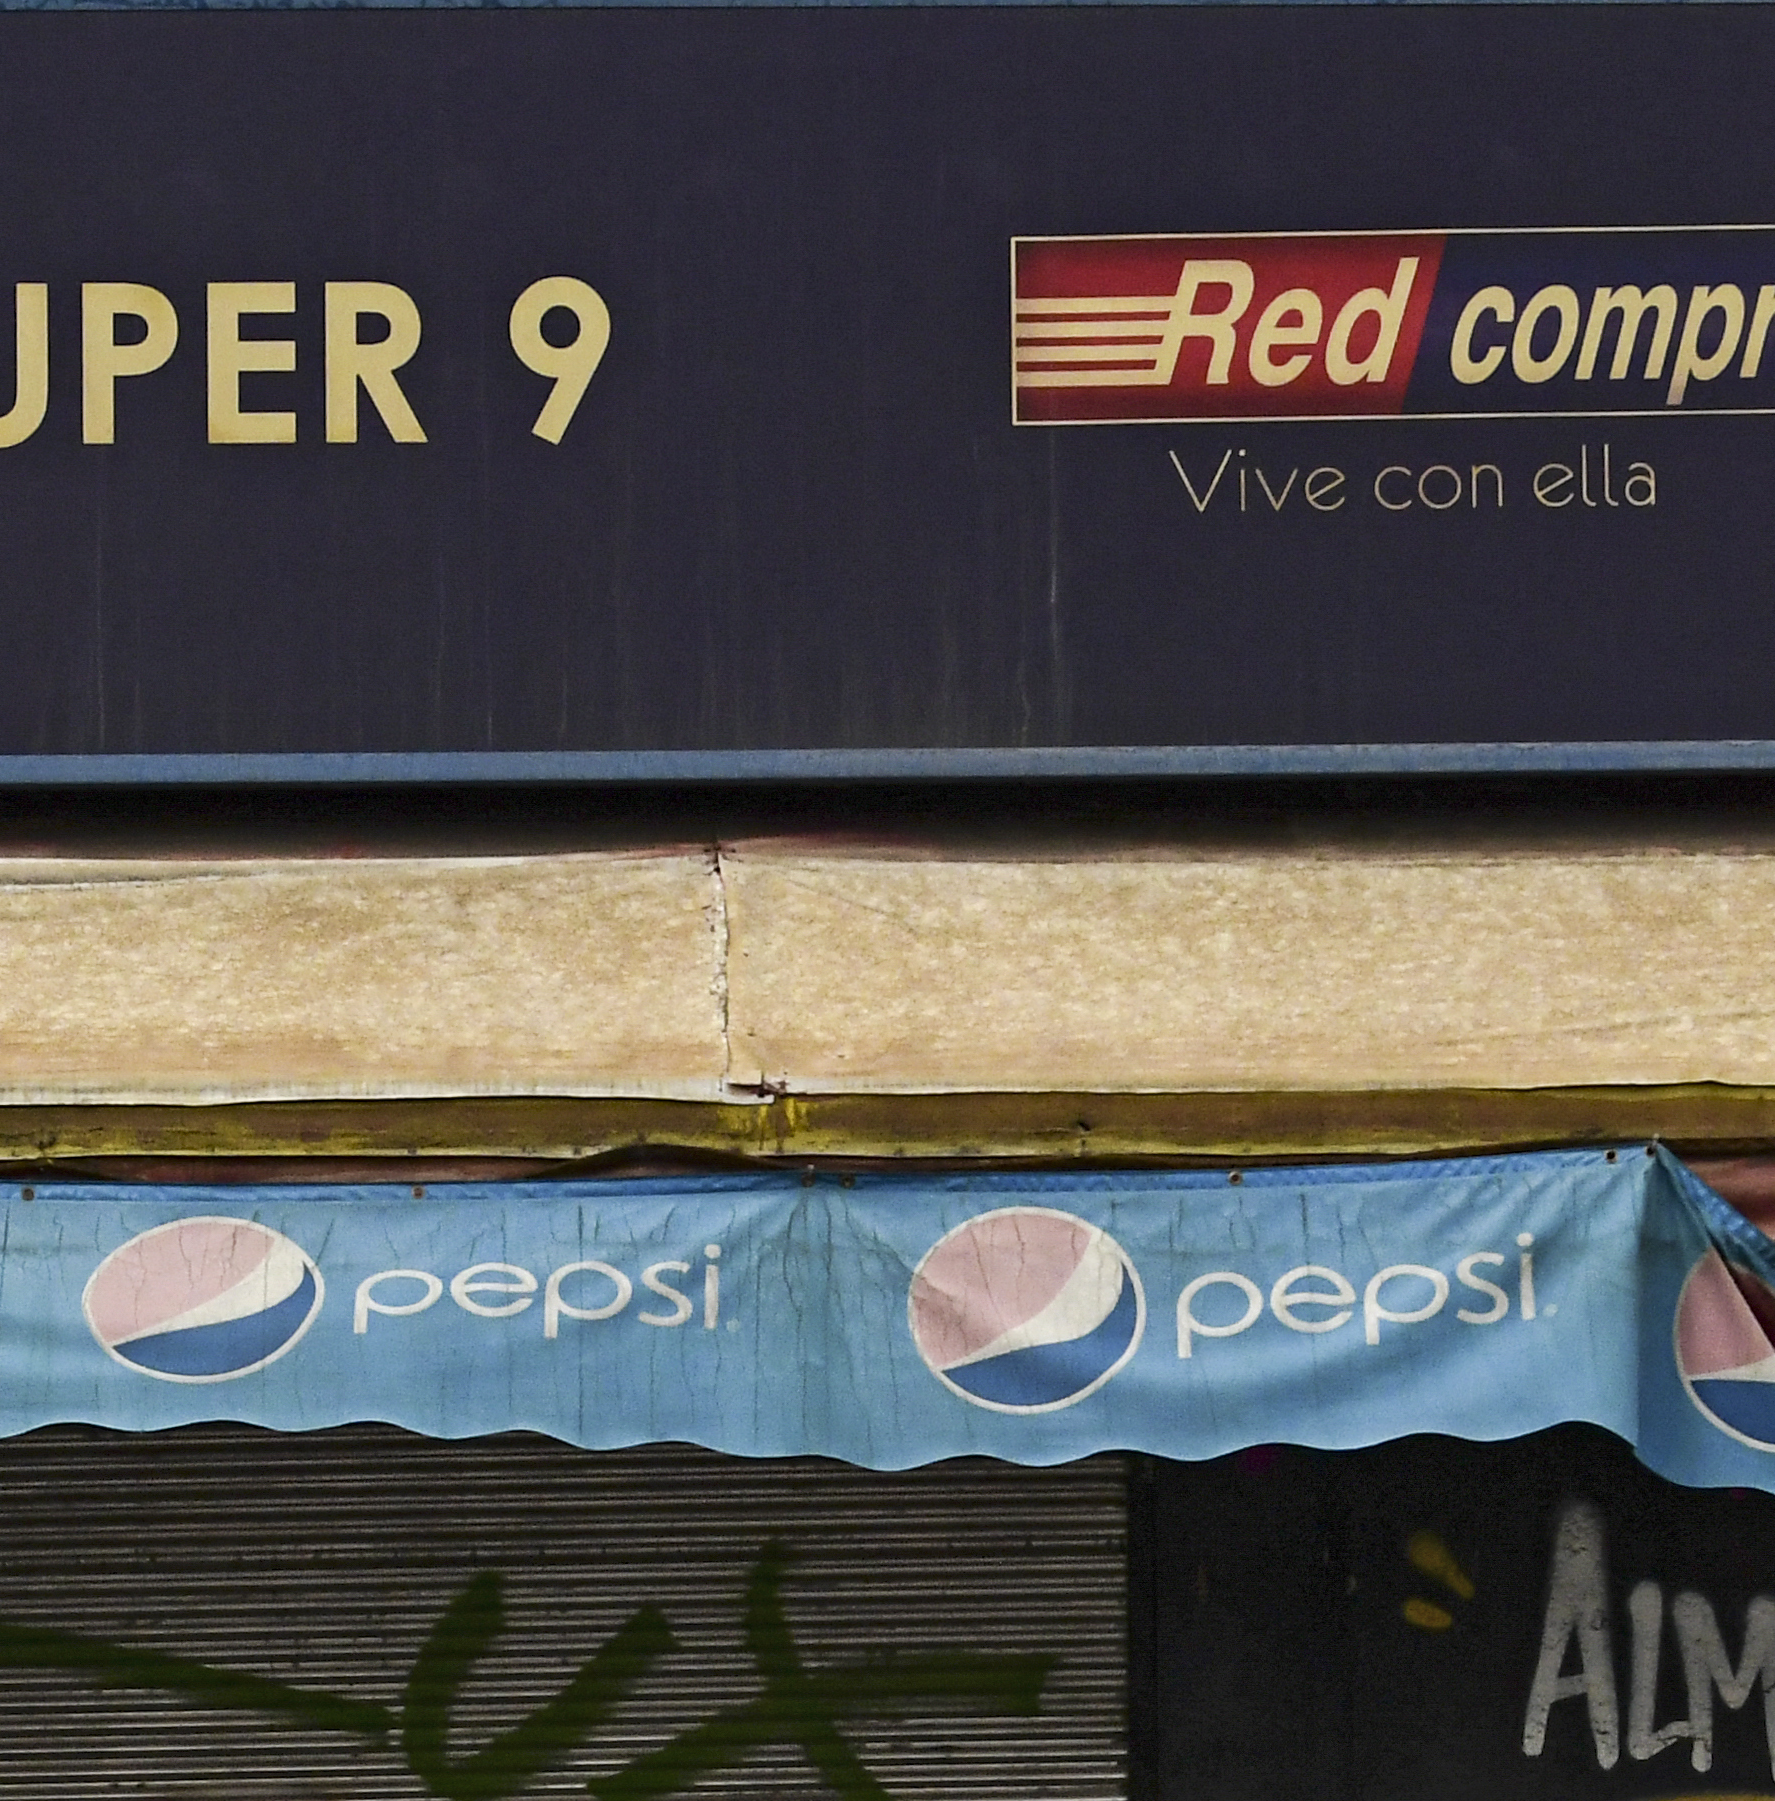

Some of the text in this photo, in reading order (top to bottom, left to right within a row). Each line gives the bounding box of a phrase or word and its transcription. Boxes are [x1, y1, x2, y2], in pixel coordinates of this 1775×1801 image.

[509, 275, 612, 446] 9
[1155, 256, 1421, 387] Red
[1168, 443, 1657, 513] Vive con ella
[353, 1244, 722, 1339] pepsi
[1176, 1232, 1537, 1359] pepsi
